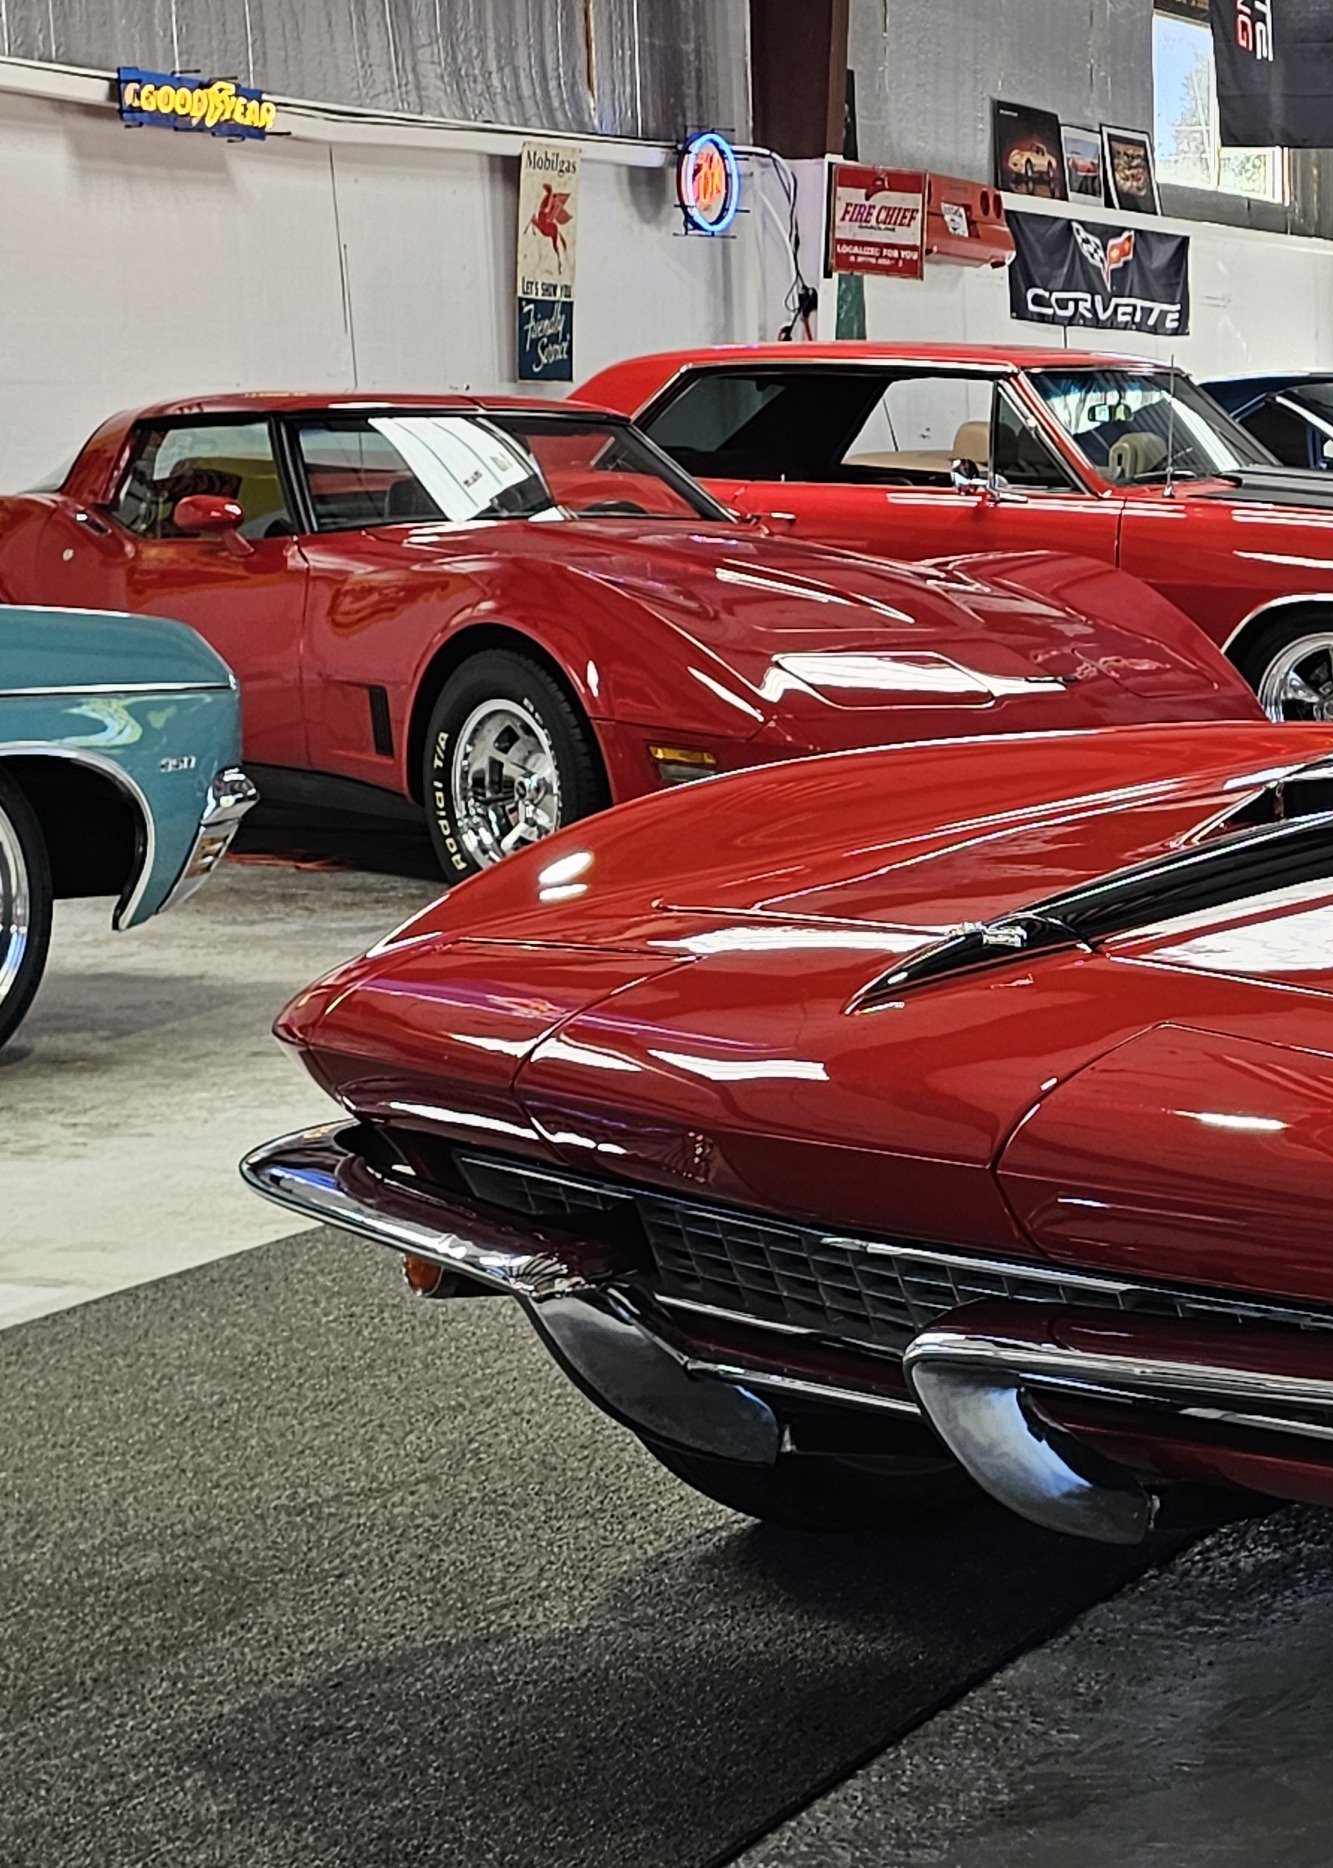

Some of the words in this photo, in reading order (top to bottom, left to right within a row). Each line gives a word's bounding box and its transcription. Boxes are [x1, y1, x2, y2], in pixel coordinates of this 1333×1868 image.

[138, 80, 277, 129] GOODYEAR
[525, 150, 577, 177] Mobilgas
[840, 202, 876, 224] FIRE
[876, 205, 919, 228] CHIEF
[1026, 287, 1182, 328] CORVETTE
